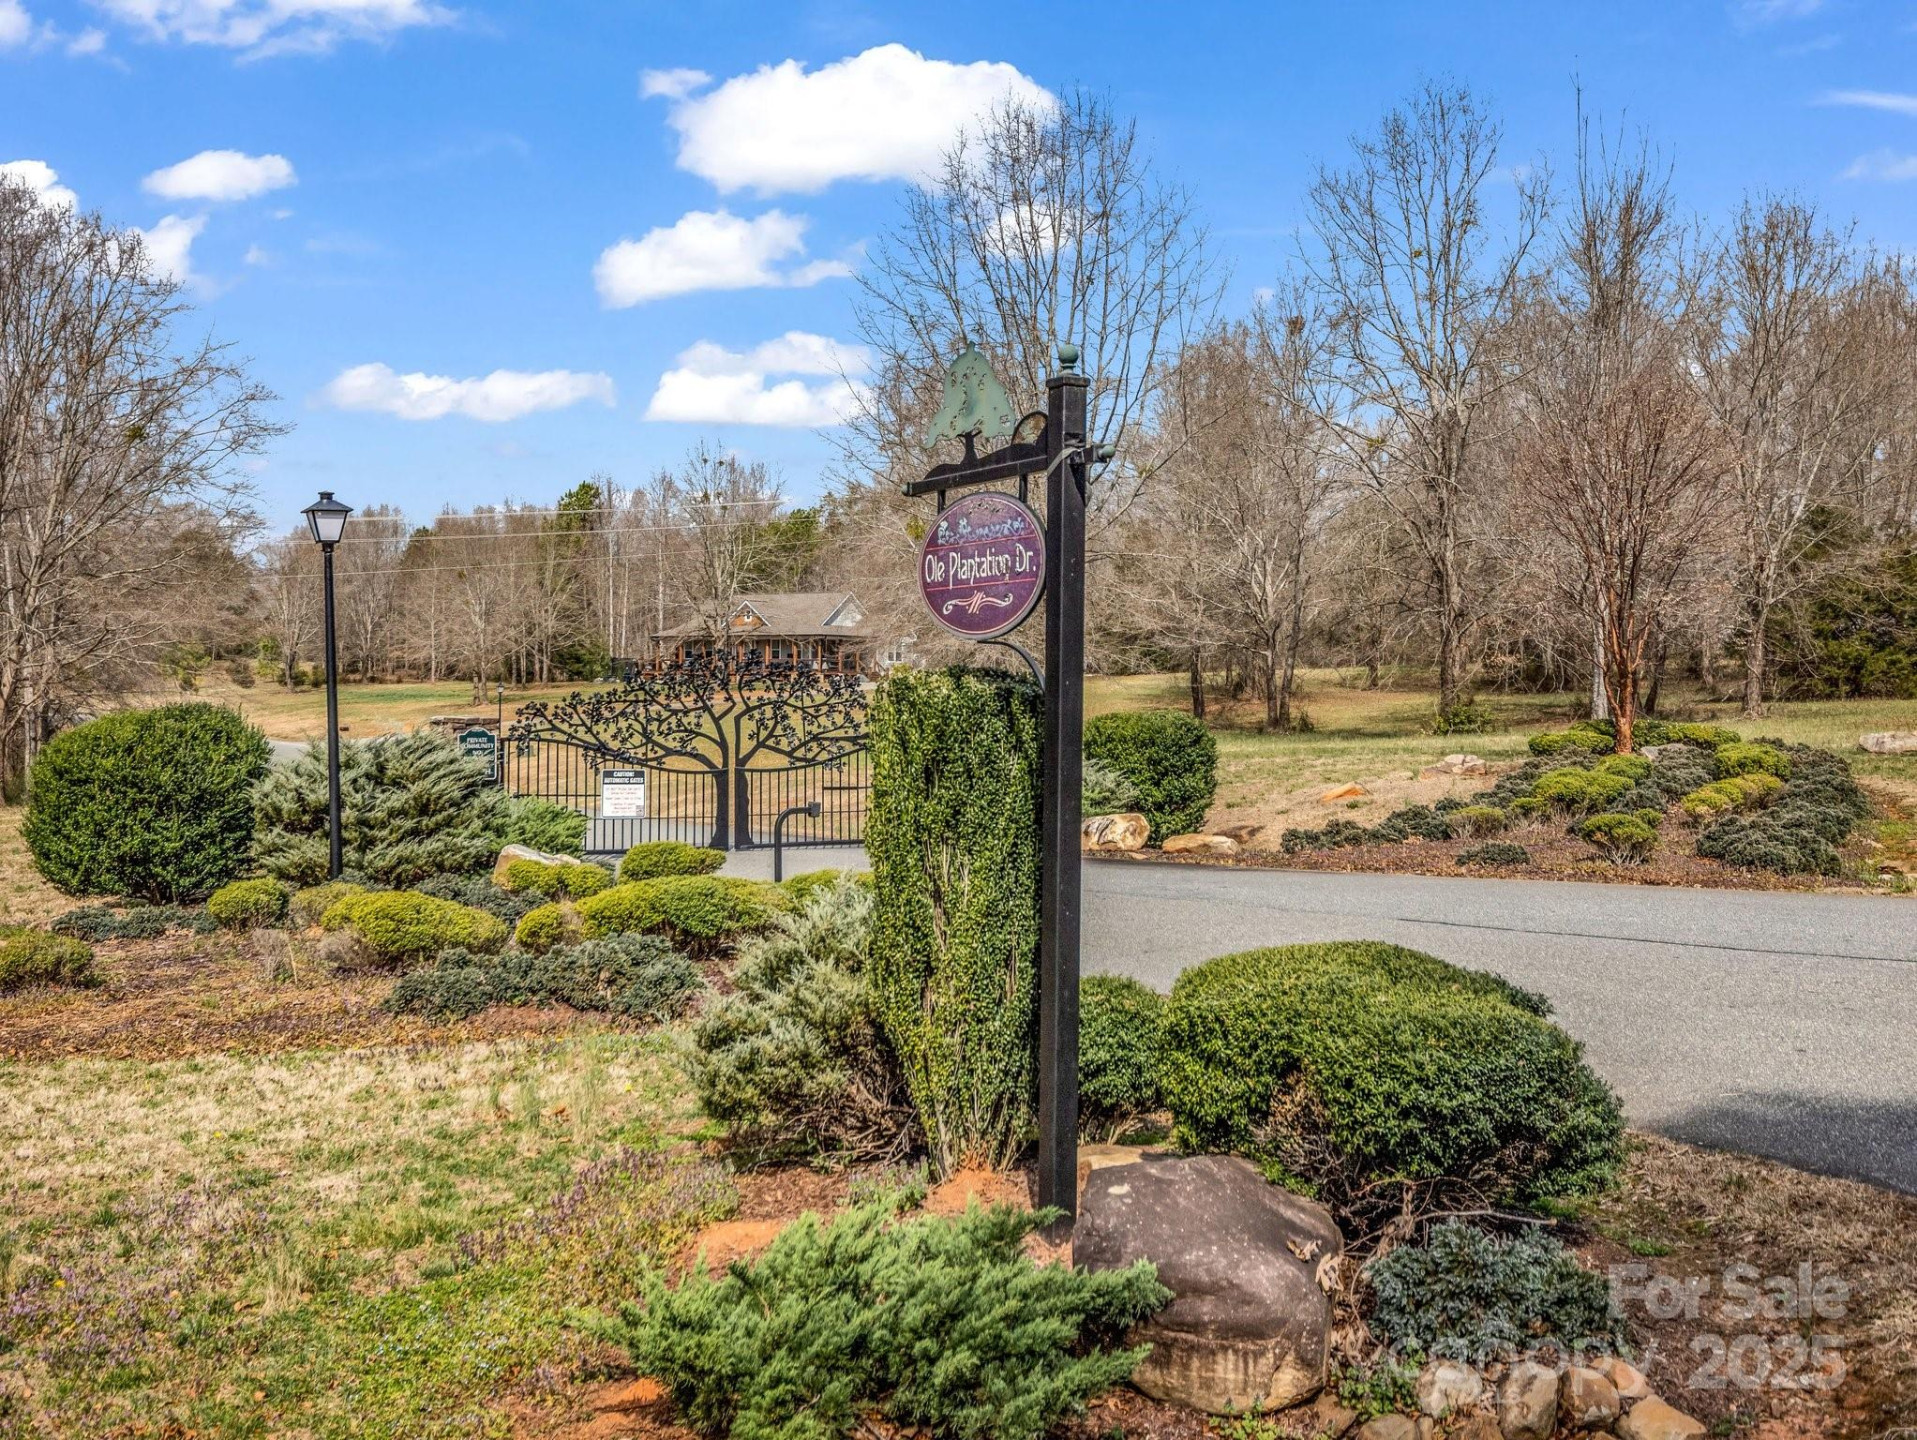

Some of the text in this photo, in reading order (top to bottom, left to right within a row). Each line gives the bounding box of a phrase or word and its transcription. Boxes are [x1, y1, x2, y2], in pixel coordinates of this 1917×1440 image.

[925, 543, 1037, 589] Ole Plantation Dr.
